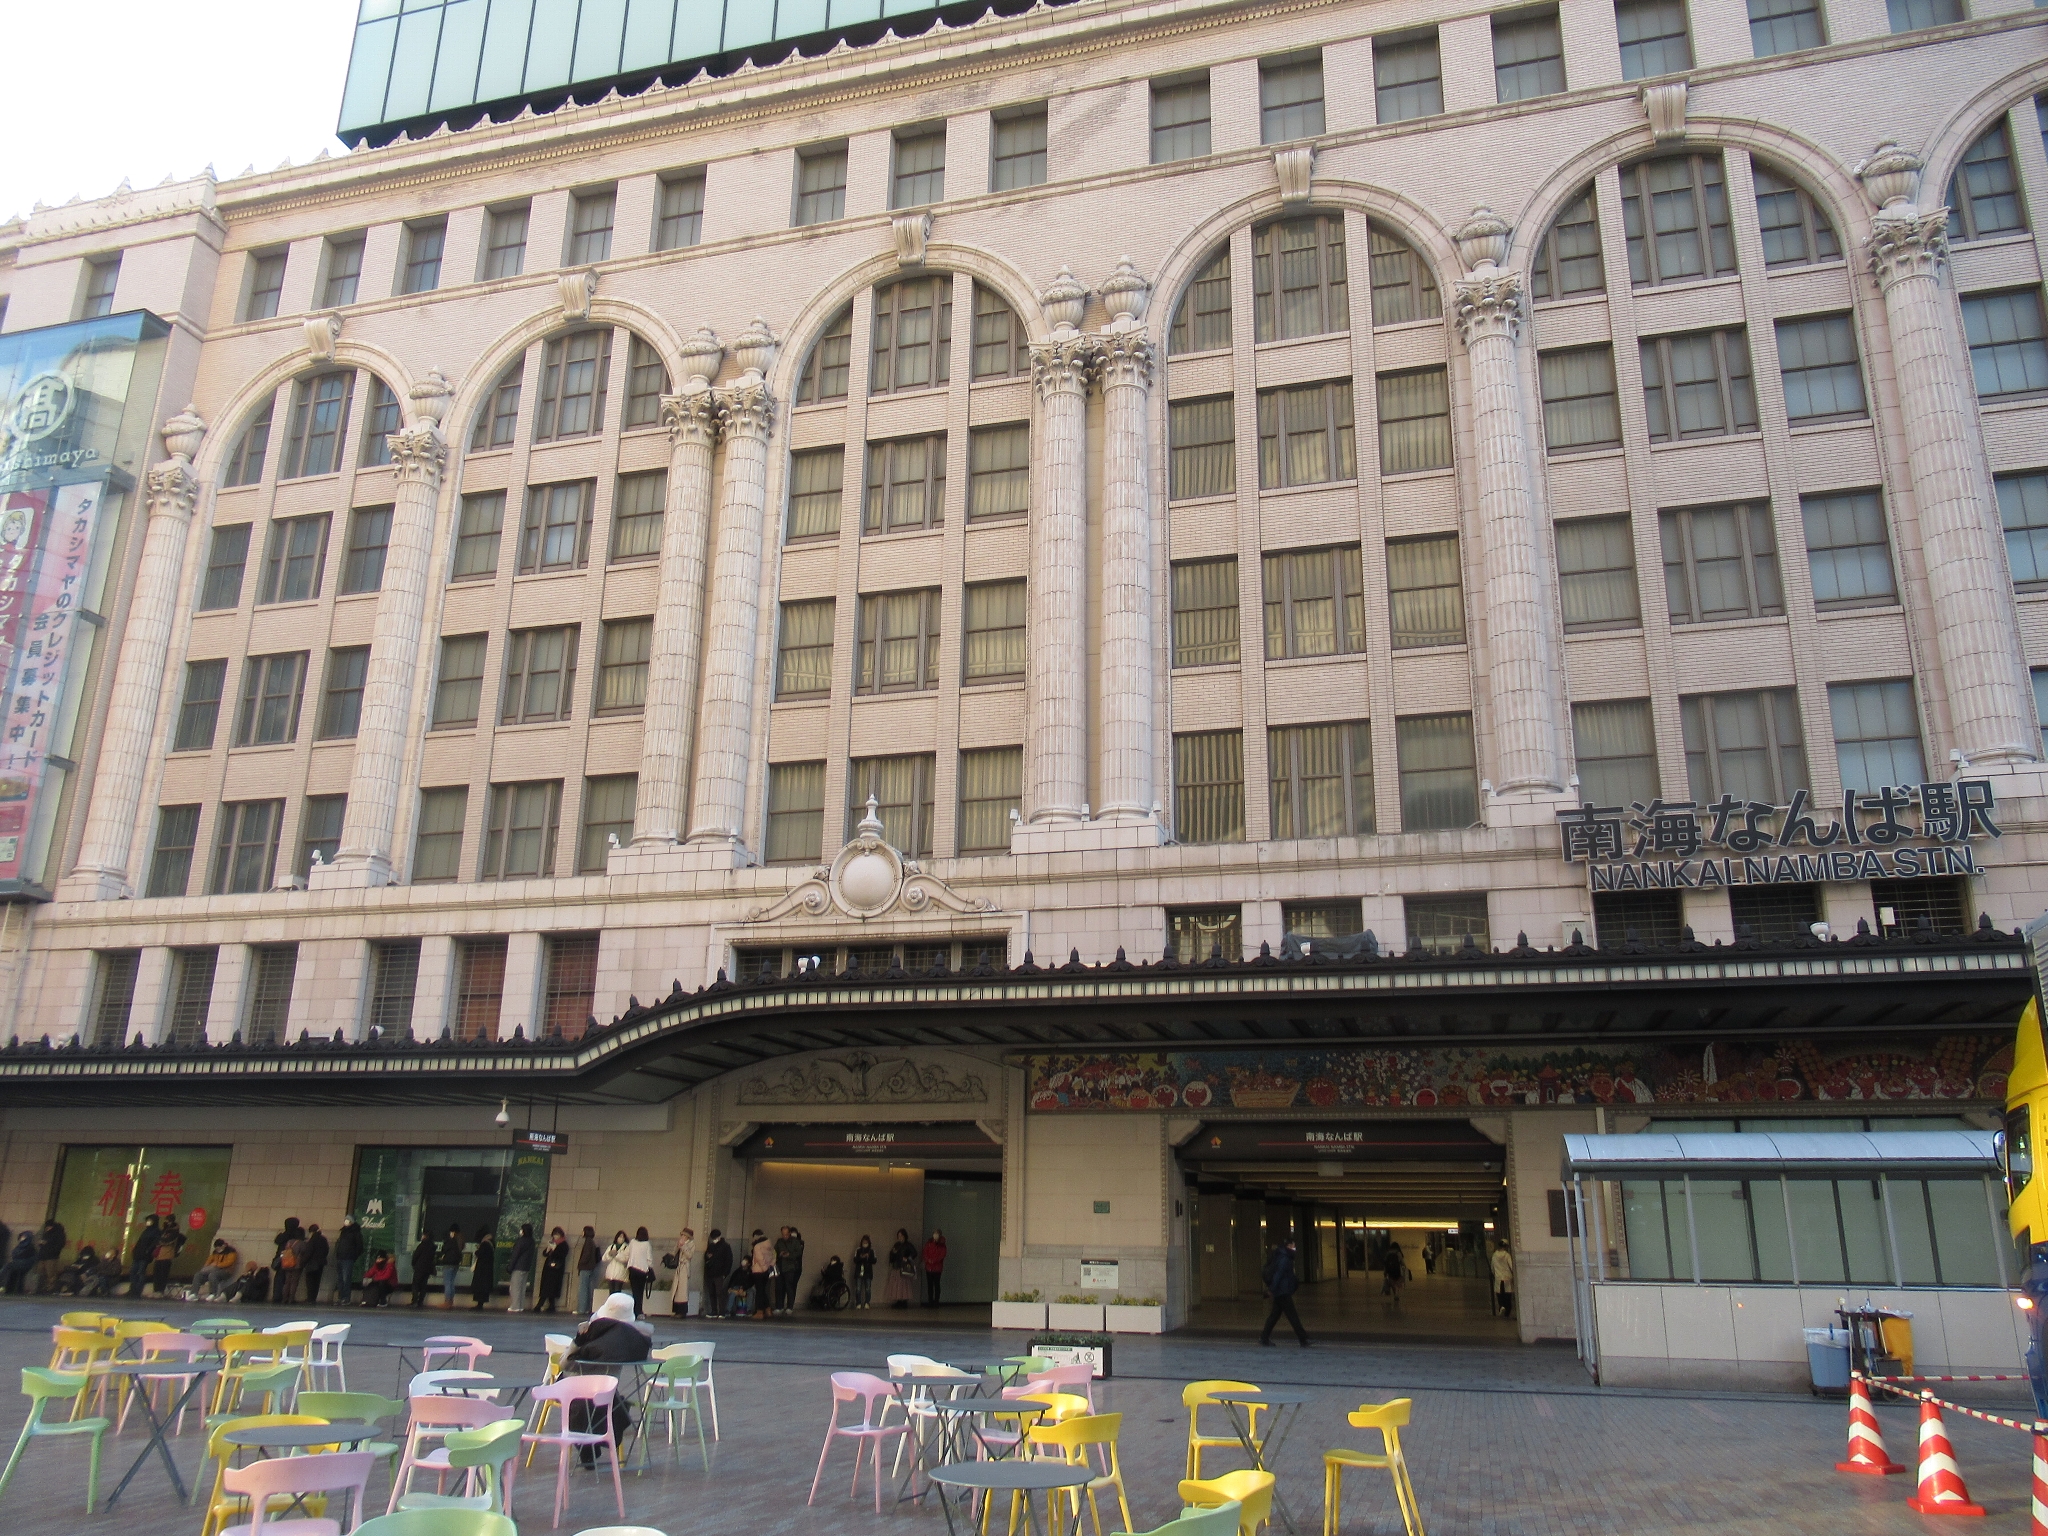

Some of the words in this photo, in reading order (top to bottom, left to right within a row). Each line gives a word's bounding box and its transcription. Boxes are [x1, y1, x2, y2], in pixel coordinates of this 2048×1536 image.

[24, 498, 93, 768] タカシマヤのクレジットカード
[1556, 780, 2003, 862] 南海なんば駅
[1589, 857, 1733, 892] NANKAI
[1743, 849, 1889, 885] NAMBA
[1893, 845, 1986, 878] STN.
[846, 1133, 895, 1143] 南海なんば駅
[1305, 1132, 1364, 1142] 南海なんば駅
[97, 1170, 184, 1217] 初春
